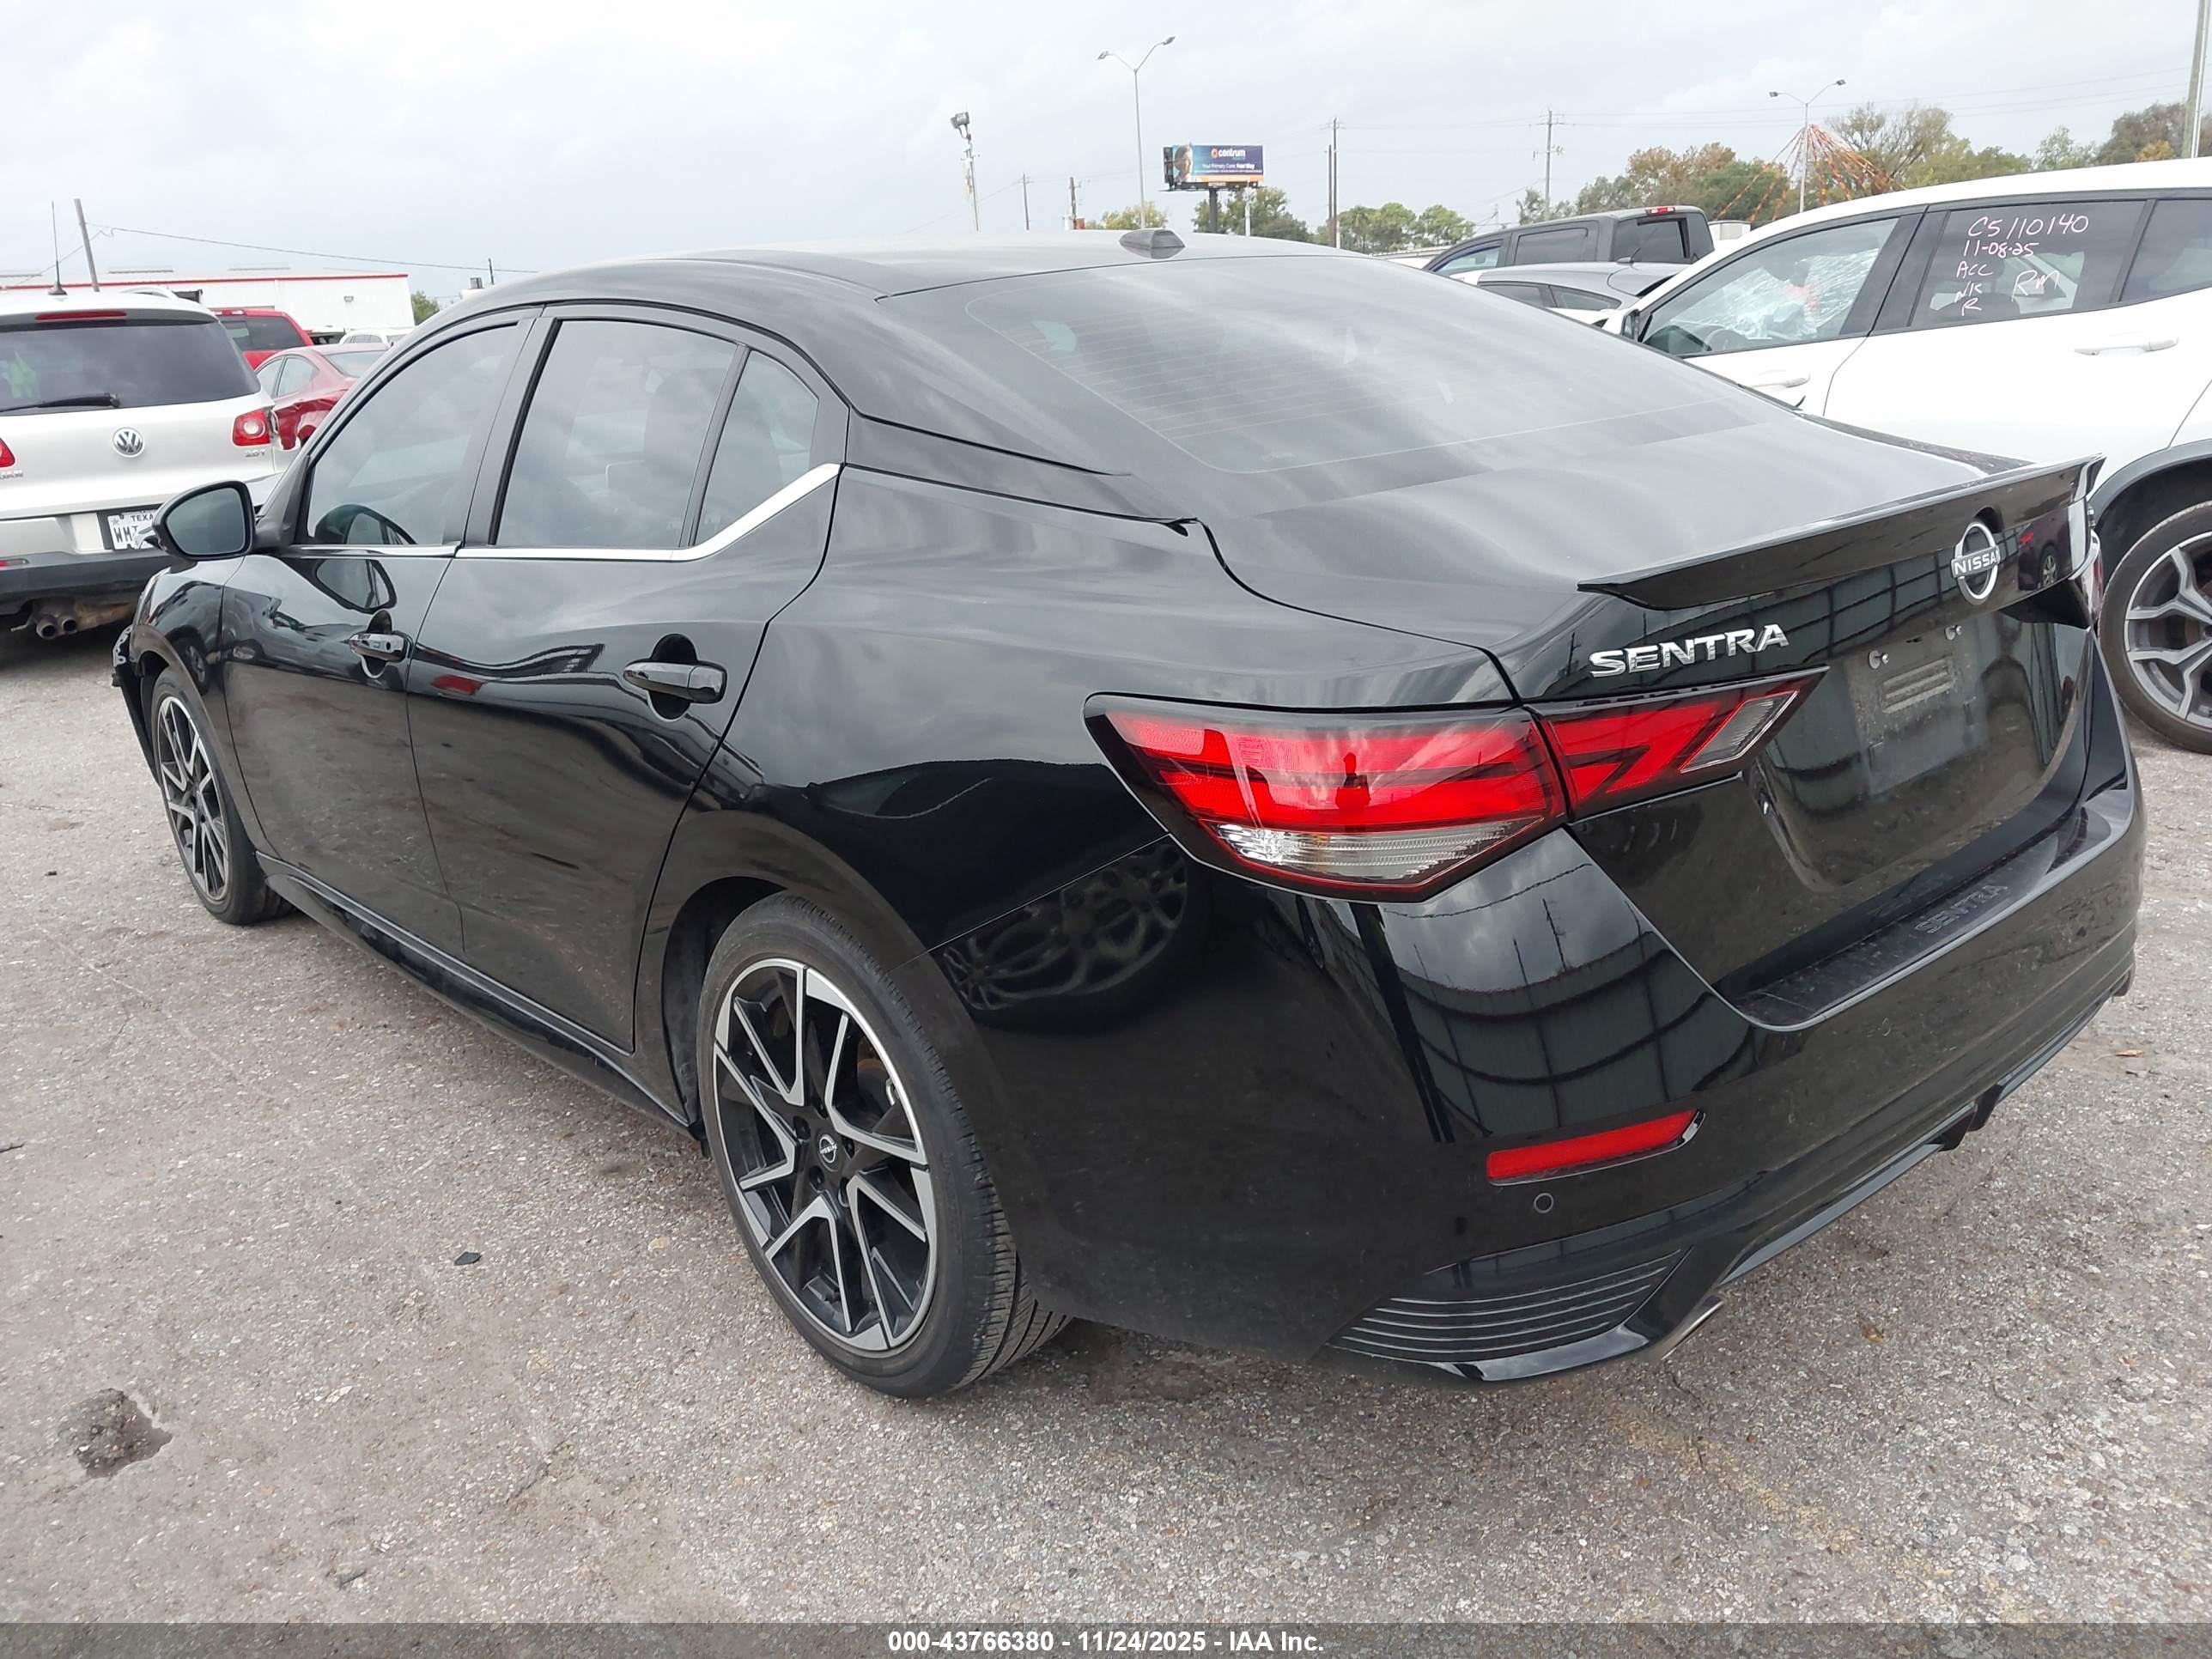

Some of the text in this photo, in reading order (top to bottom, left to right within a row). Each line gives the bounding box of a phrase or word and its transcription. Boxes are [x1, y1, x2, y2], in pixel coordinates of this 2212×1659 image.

[131, 513, 154, 522] TEXA
[1589, 623, 1790, 678] SENTRA
[1914, 884, 2008, 933] SENTRA
